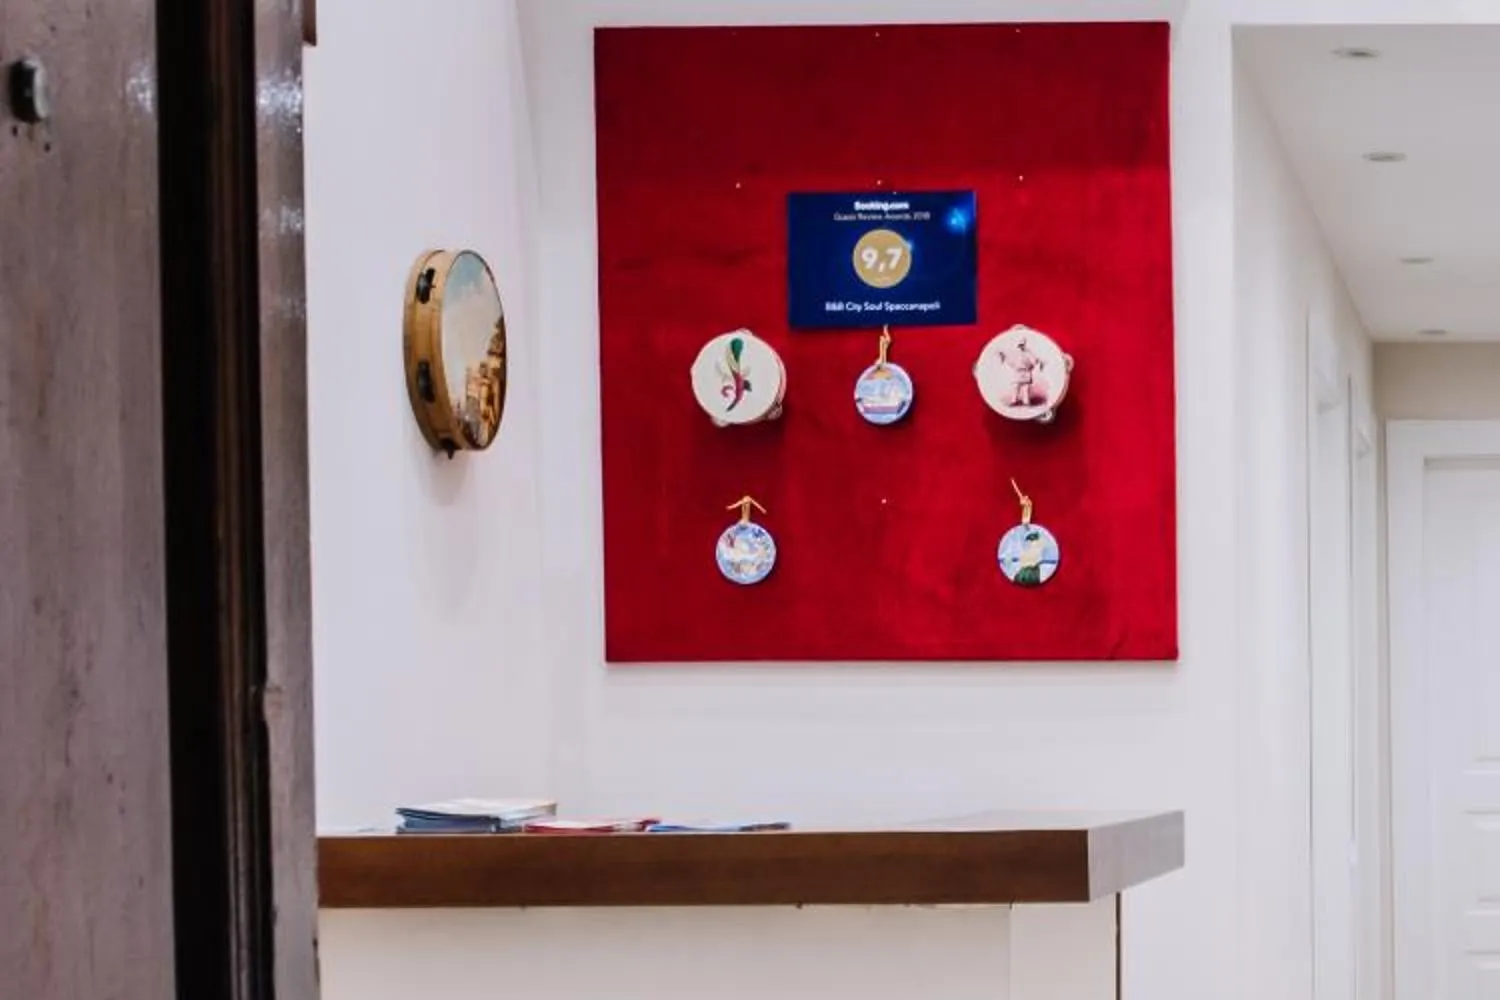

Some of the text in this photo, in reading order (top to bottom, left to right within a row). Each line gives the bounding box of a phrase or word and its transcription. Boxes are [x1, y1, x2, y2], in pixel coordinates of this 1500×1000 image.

[854, 201, 909, 212] Booking.com
[857, 212, 882, 220] Review
[861, 247, 902, 272] 9,7
[825, 301, 844, 311] B&B
[846, 301, 862, 312] City
[864, 301, 882, 311] Soul
